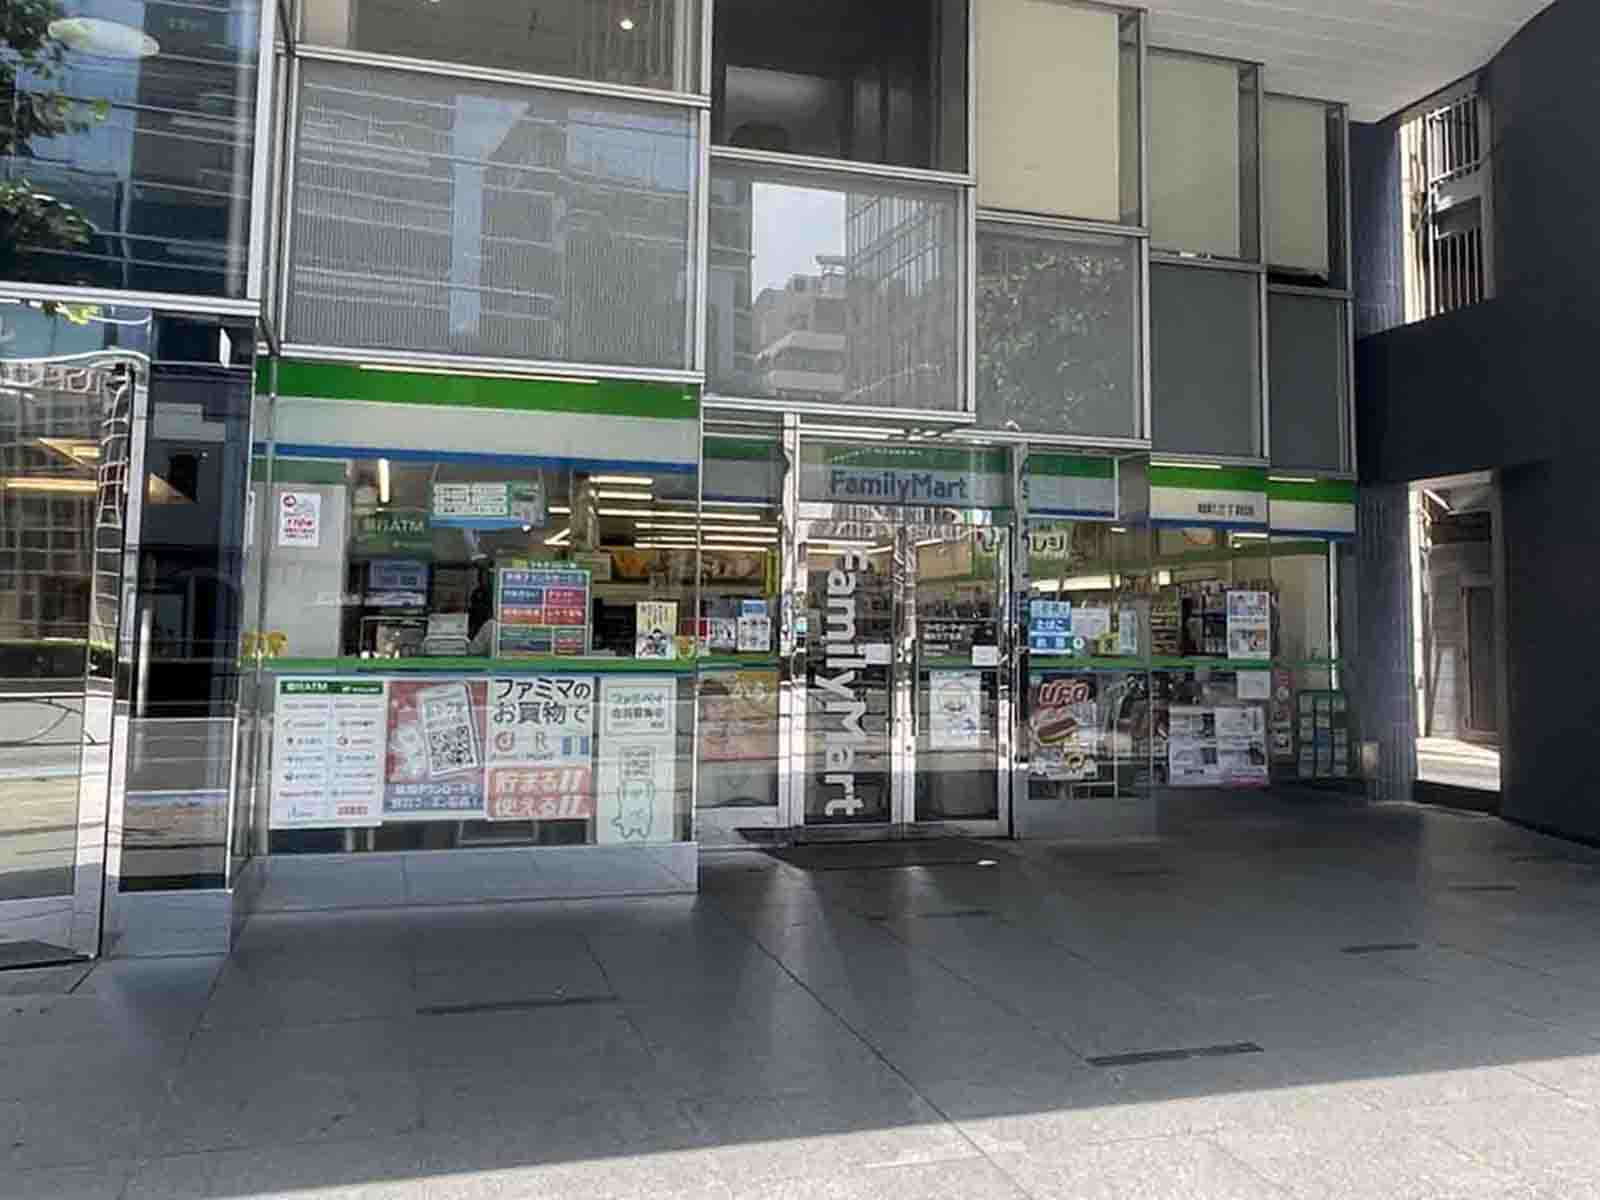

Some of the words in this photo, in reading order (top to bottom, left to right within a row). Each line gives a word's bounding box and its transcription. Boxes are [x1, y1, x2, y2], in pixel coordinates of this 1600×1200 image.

[831, 470, 969, 503] FamilyMart
[496, 679, 592, 700] ファミマの
